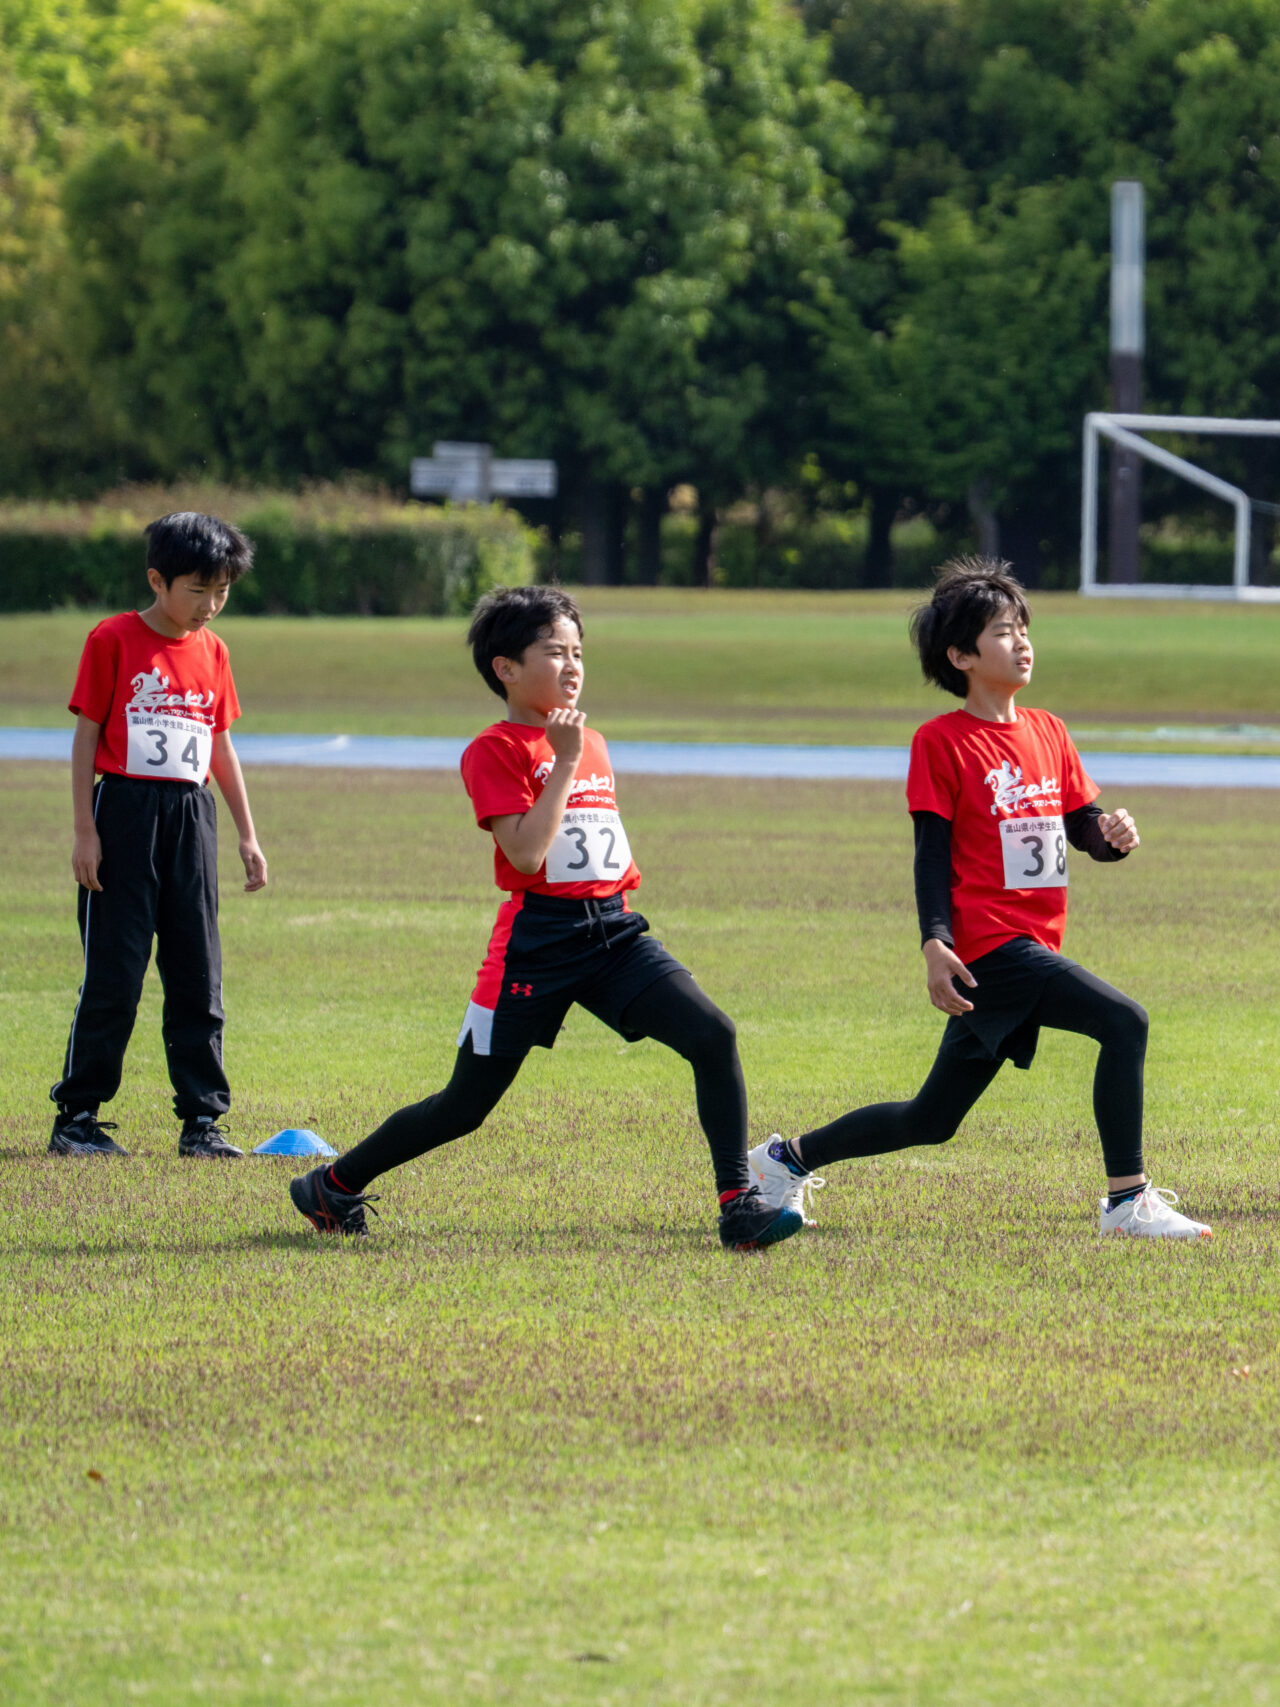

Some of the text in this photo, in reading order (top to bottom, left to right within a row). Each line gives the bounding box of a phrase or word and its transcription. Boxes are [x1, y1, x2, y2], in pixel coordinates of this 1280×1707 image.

[146, 729, 200, 772] 34
[564, 827, 620, 870] 32
[1020, 834, 1066, 877] 38
